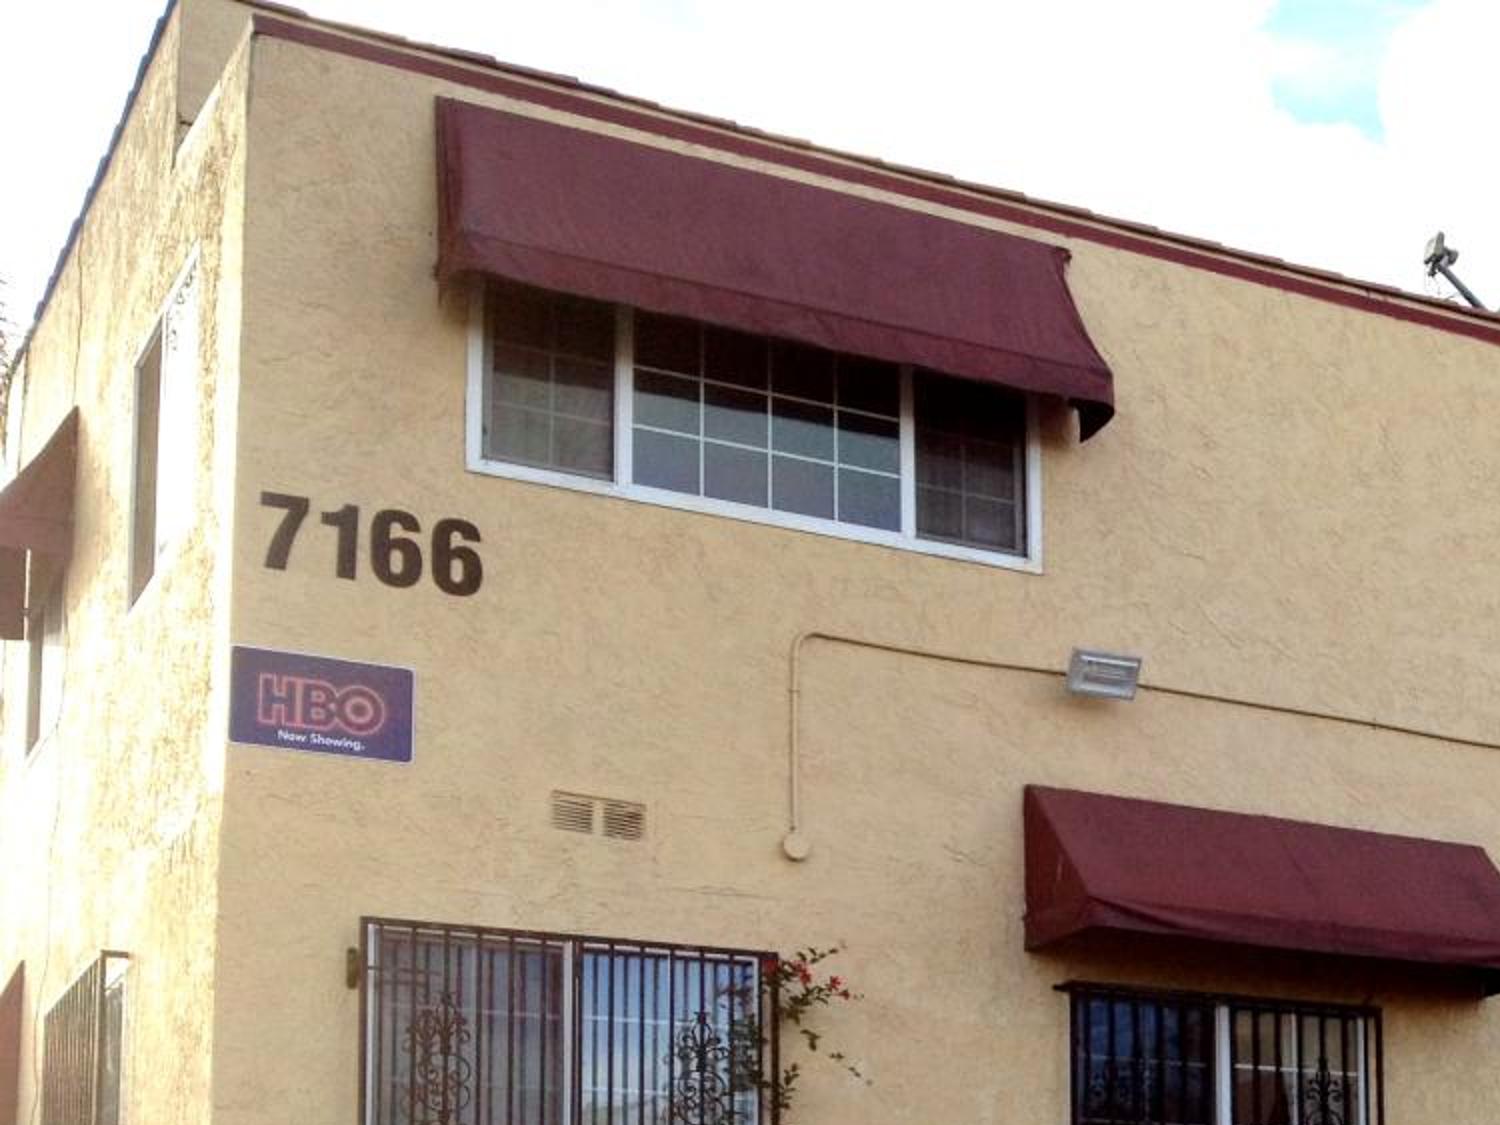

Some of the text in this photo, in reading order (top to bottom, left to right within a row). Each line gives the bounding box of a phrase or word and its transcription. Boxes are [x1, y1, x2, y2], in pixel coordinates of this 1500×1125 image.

[260, 491, 483, 597] 7166
[257, 672, 386, 735] HBO
[277, 729, 307, 742] Now
